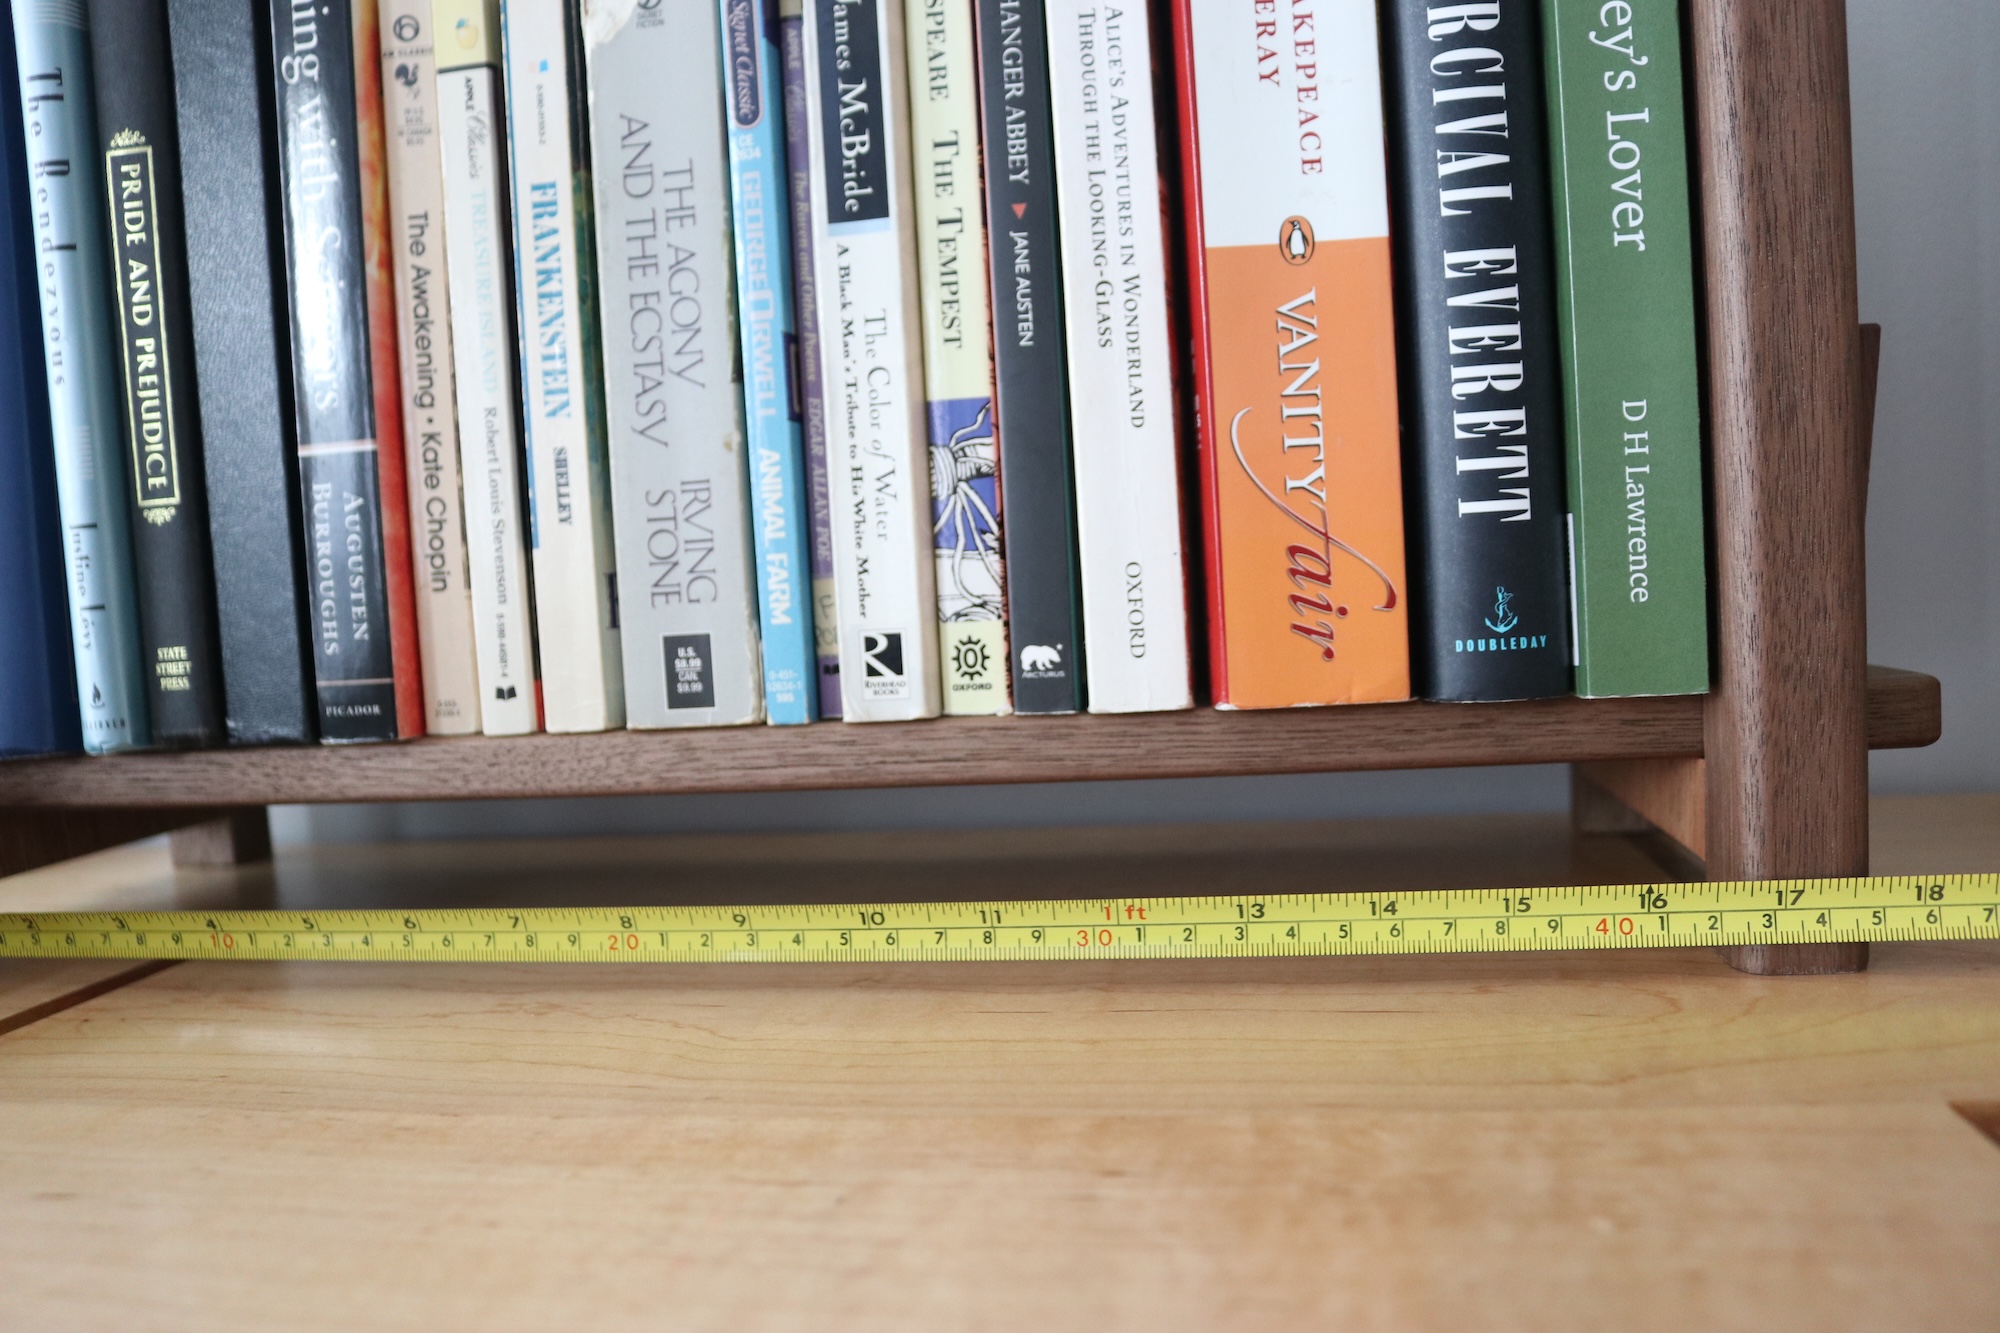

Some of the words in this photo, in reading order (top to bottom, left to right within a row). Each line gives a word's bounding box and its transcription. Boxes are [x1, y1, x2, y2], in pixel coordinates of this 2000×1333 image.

[729, 1, 750, 53] Signet
[785, 28, 798, 69] APPLE
[1588, 0, 1649, 92] ey's
[465, 76, 475, 111] APPLE
[736, 56, 756, 119] Classic
[1078, 11, 1098, 113] THROUGH
[27, 67, 63, 136] The
[1426, 0, 1513, 217] RCIVAL
[297, 96, 339, 200] with
[620, 113, 655, 199] AND
[838, 78, 874, 213] McBride
[932, 130, 959, 198] THE
[1005, 105, 1031, 187] ABBEY
[1085, 121, 1101, 161] THE
[1111, 97, 1134, 237] ADVENTURES
[120, 163, 147, 247] PRIDE
[664, 158, 697, 231] THE
[793, 171, 808, 199] The
[1606, 107, 1650, 252] Lover
[407, 210, 430, 256] The
[471, 187, 493, 304] TREASURE
[626, 208, 659, 282] THE
[742, 171, 766, 290] GEORGE
[838, 243, 850, 258] A
[1009, 230, 1031, 276] JANE
[1088, 170, 1113, 348] LOOKING-GLASS
[1121, 244, 1136, 266] IN
[34, 159, 77, 385] Rendezvous
[129, 259, 151, 326] AND
[839, 263, 853, 311] Black
[936, 207, 963, 349] TEMPEST
[311, 224, 344, 412] Sirs
[412, 262, 436, 419] Awakening
[667, 242, 706, 390] AGONY
[799, 285, 815, 328] Other
[864, 308, 886, 359] The
[1013, 276, 1034, 347] AUSTEN
[479, 311, 498, 394] ISLAND
[531, 181, 570, 420] FRANKENSTEIN
[553, 447, 572, 526] SHELLEY
[628, 293, 668, 448] ECSTASY
[745, 290, 776, 418] ORWELL
[802, 331, 818, 382] Poems
[842, 318, 857, 372] Man's
[1122, 273, 1146, 429] WONDERLAND
[135, 338, 167, 490] PREJUDICE
[845, 379, 860, 439] Tribute
[867, 367, 891, 430] Color
[1275, 287, 1327, 501] VANITY
[1443, 244, 1532, 523] EVERETT
[1622, 398, 1647, 422] D
[421, 432, 443, 489] Kate
[484, 407, 500, 463] Robert
[808, 398, 824, 456] EDGAR
[850, 443, 860, 460] to
[863, 440, 887, 466] of
[1624, 430, 1650, 456] H
[488, 469, 504, 516] Louis
[759, 447, 783, 548] ANIMAL
[812, 463, 829, 519] ALLAN
[851, 467, 865, 495] His
[874, 468, 897, 542] Water
[424, 499, 450, 595] Chopin
[646, 490, 681, 609] STONE
[680, 479, 718, 605] IRVING
[815, 524, 831, 562] POE
[852, 498, 867, 550] White
[1624, 464, 1650, 604] Lawrence
[69, 523, 97, 598] Justine
[312, 482, 339, 657] BURROUGHS
[343, 492, 369, 642] AUGUSTEN
[491, 520, 508, 605] Stevenson
[765, 553, 792, 625] FARM
[855, 557, 869, 619] Mother
[1125, 561, 1147, 660] OXFORD
[1455, 634, 1548, 652] DOUBLEDAY
[156, 661, 191, 677] STREET
[157, 646, 188, 661] STATE
[160, 676, 190, 691] PRESS
[952, 683, 992, 692] OXFORD
[1022, 671, 1065, 679] ARCTURUS
[325, 703, 382, 717] PICADOR
[872, 688, 899, 696] BOOKS
[210, 933, 234, 950] 10
[442, 932, 451, 947] 6
[484, 933, 492, 947] 7
[526, 933, 534, 947] 8
[567, 933, 577, 947] 9
[607, 934, 639, 950] 20
[658, 933, 665, 947] 1
[700, 933, 710, 947] 2
[746, 933, 755, 947] 3
[791, 933, 801, 946] 4
[839, 932, 848, 946] 5
[885, 931, 895, 945] 6
[934, 931, 944, 945] 7
[983, 930, 992, 944] 8
[1031, 929, 1042, 943] 9
[1076, 929, 1112, 947] 30
[1135, 927, 1142, 942] 1
[1183, 927, 1193, 942] 2
[1234, 926, 1245, 941] 3
[1286, 925, 1296, 940] 4
[1338, 924, 1349, 939] 5
[1389, 923, 1401, 938] 6
[1443, 921, 1454, 936] 7
[1495, 920, 1506, 935] 8
[1547, 919, 1559, 934] 9
[1595, 917, 1634, 935] 40
[1658, 916, 1665, 931] 1
[1708, 915, 1719, 930] 2
[1762, 913, 1773, 928] 3
[1815, 912, 1828, 927] 4
[1872, 910, 1883, 926] 5
[1926, 909, 1938, 924] 6
[1982, 907, 1994, 922] 7
[302, 917, 315, 930] 5
[403, 916, 417, 929] 6
[507, 915, 519, 929] 7
[619, 915, 633, 929] 8
[733, 913, 746, 927] 9
[859, 911, 885, 925] 10
[979, 909, 1002, 924] 11
[1237, 903, 1265, 919] 13
[1369, 901, 1398, 916] 14
[1503, 897, 1531, 913] 15
[1639, 893, 1668, 909] 16
[1775, 889, 1805, 906] 17
[1915, 884, 1944, 902] 18
